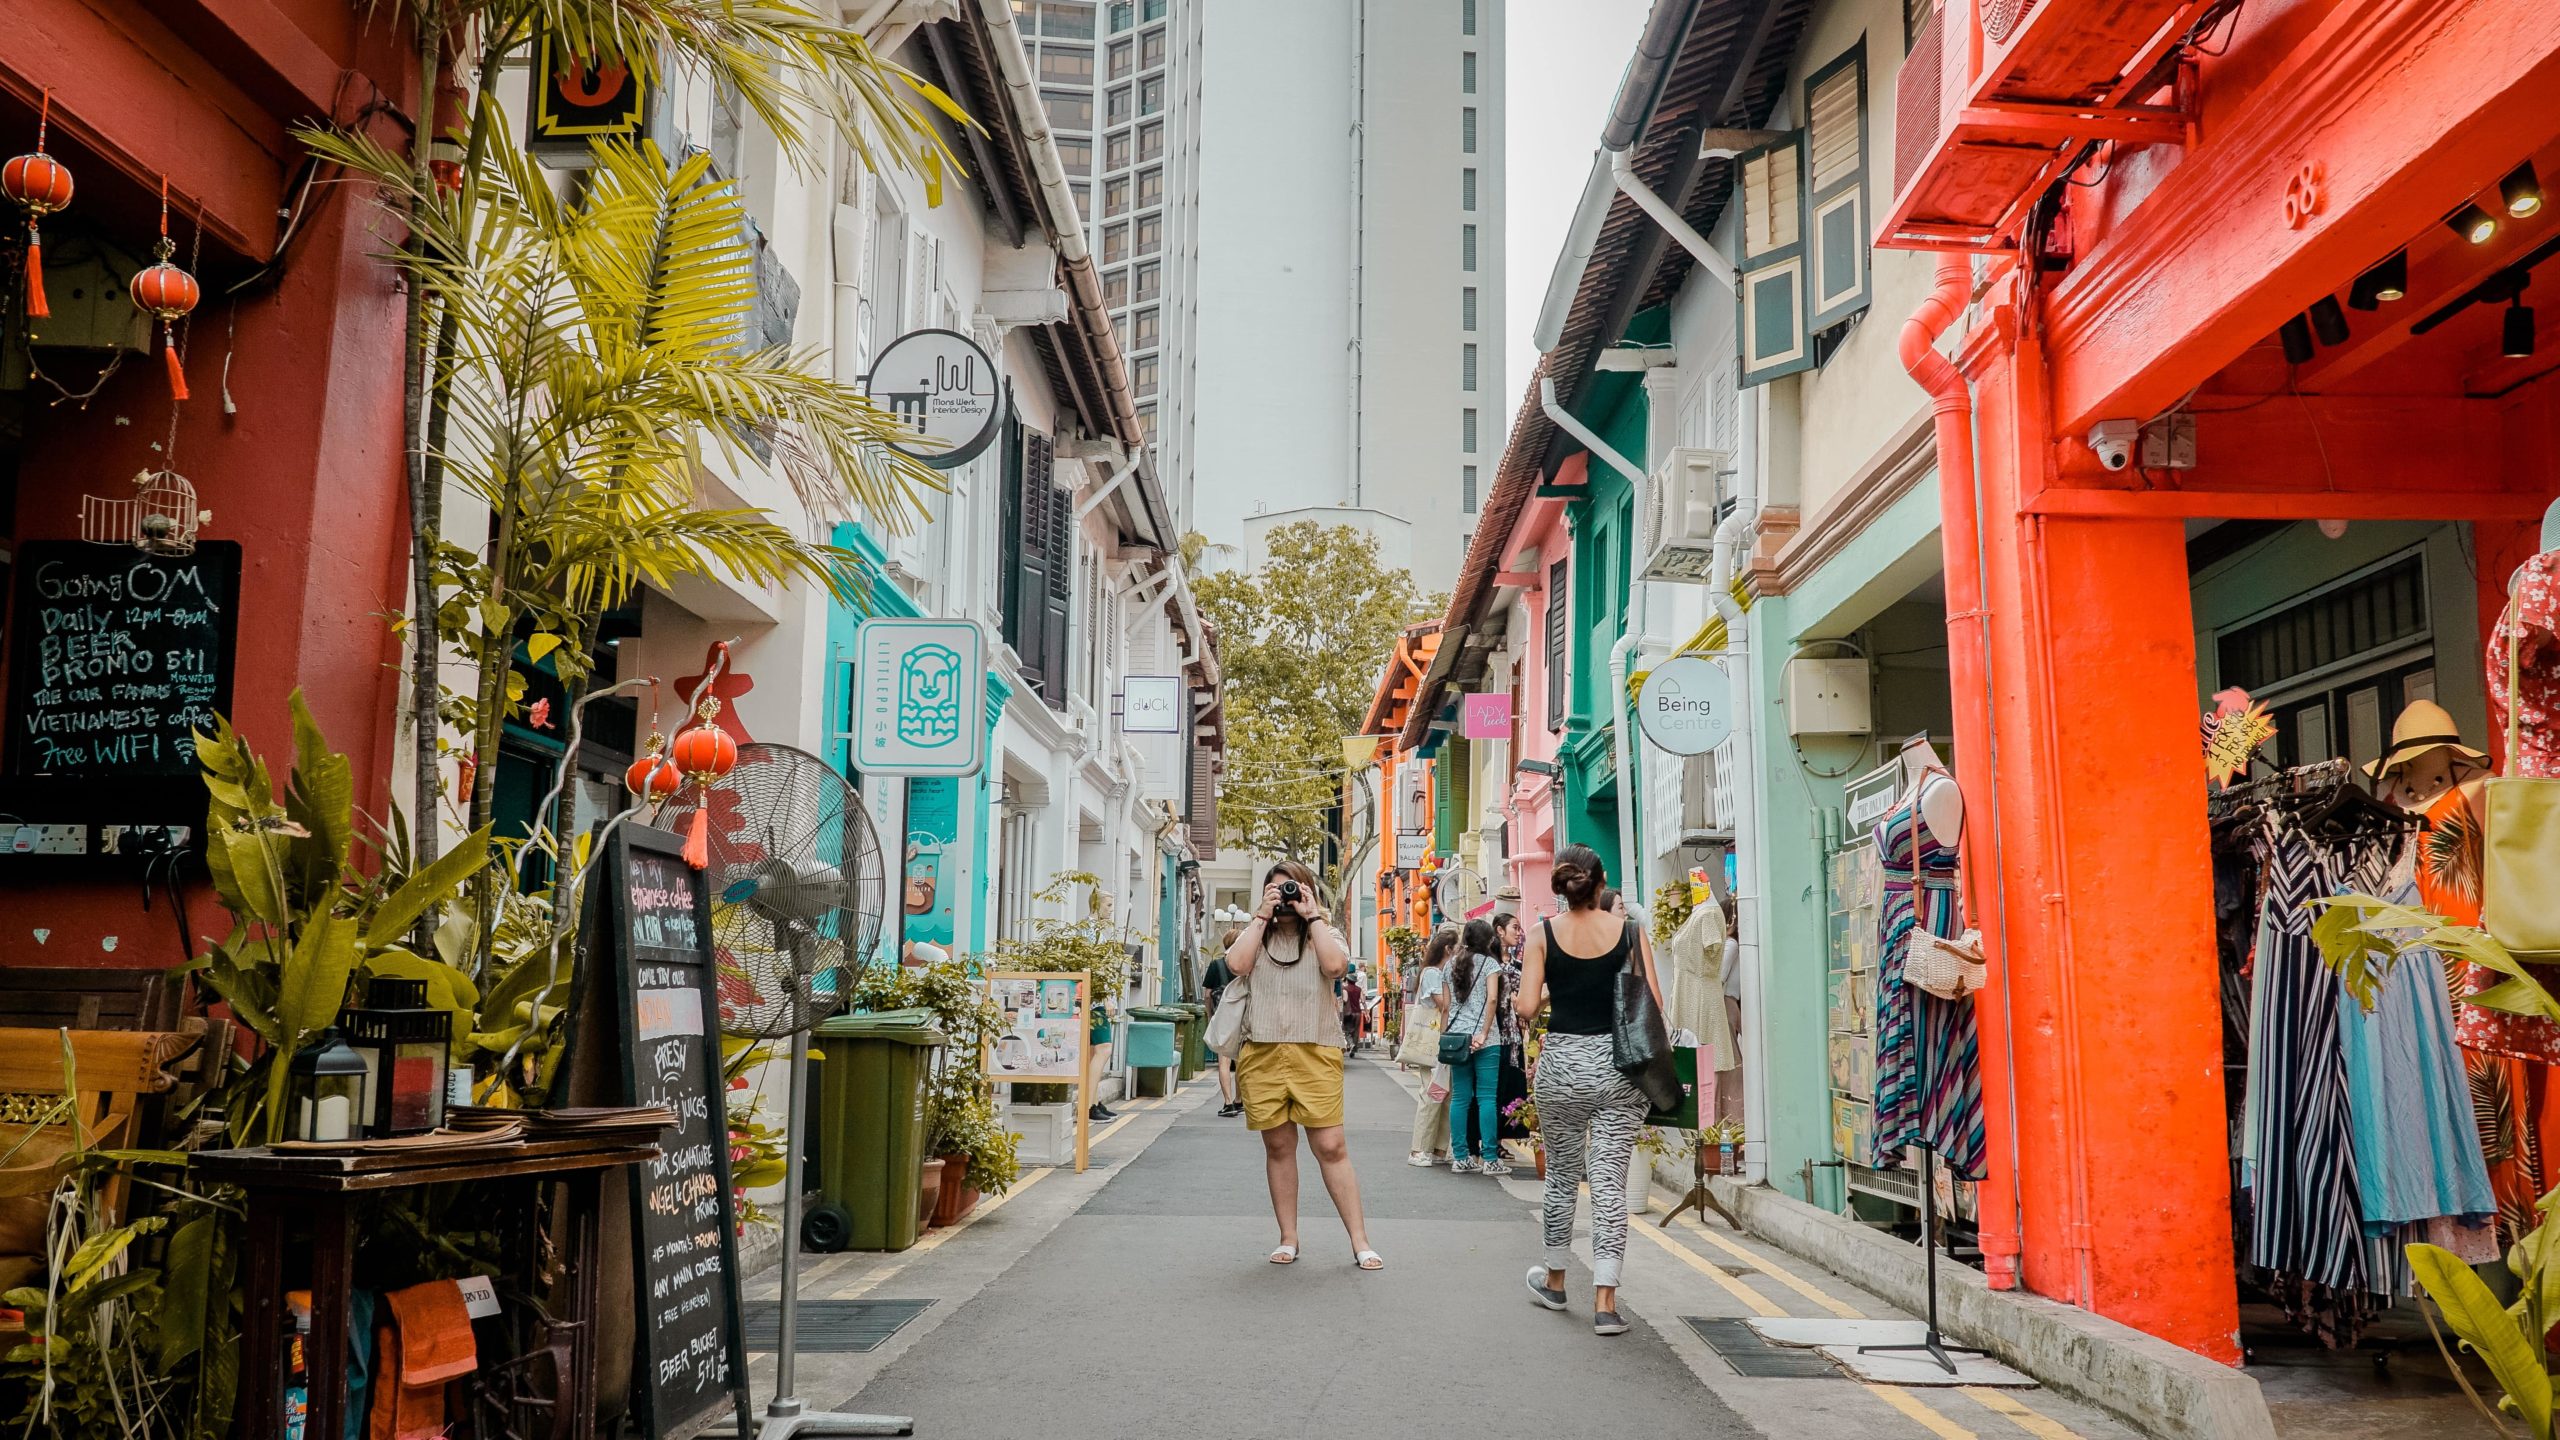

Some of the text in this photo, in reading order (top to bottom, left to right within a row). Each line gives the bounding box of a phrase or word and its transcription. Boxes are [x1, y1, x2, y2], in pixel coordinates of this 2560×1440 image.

[2282, 161, 2316, 230] 68
[932, 405, 987, 416] Interior Design
[41, 604, 112, 634] Daily
[41, 629, 136, 666] BEER
[42, 650, 154, 687] PROMO
[26, 706, 214, 735] VIETNAMESE coffee
[1469, 705, 1504, 718] LADY
[1658, 696, 1710, 716] Being
[1659, 714, 1722, 730] Centre
[94, 733, 160, 764] WIFI
[2213, 727, 2234, 750] FOR
[2225, 736, 2246, 755] FOR
[638, 966, 686, 988] COME TRY OUR
[655, 1040, 687, 1079] FRESH
[679, 1087, 707, 1135] juices
[672, 1144, 714, 1176] SIGNATURE
[682, 1173, 718, 1206] CHAKRA
[654, 1274, 669, 1299] ANY
[673, 1263, 693, 1291] MAIN
[659, 1327, 717, 1386] BEER BUCKET
